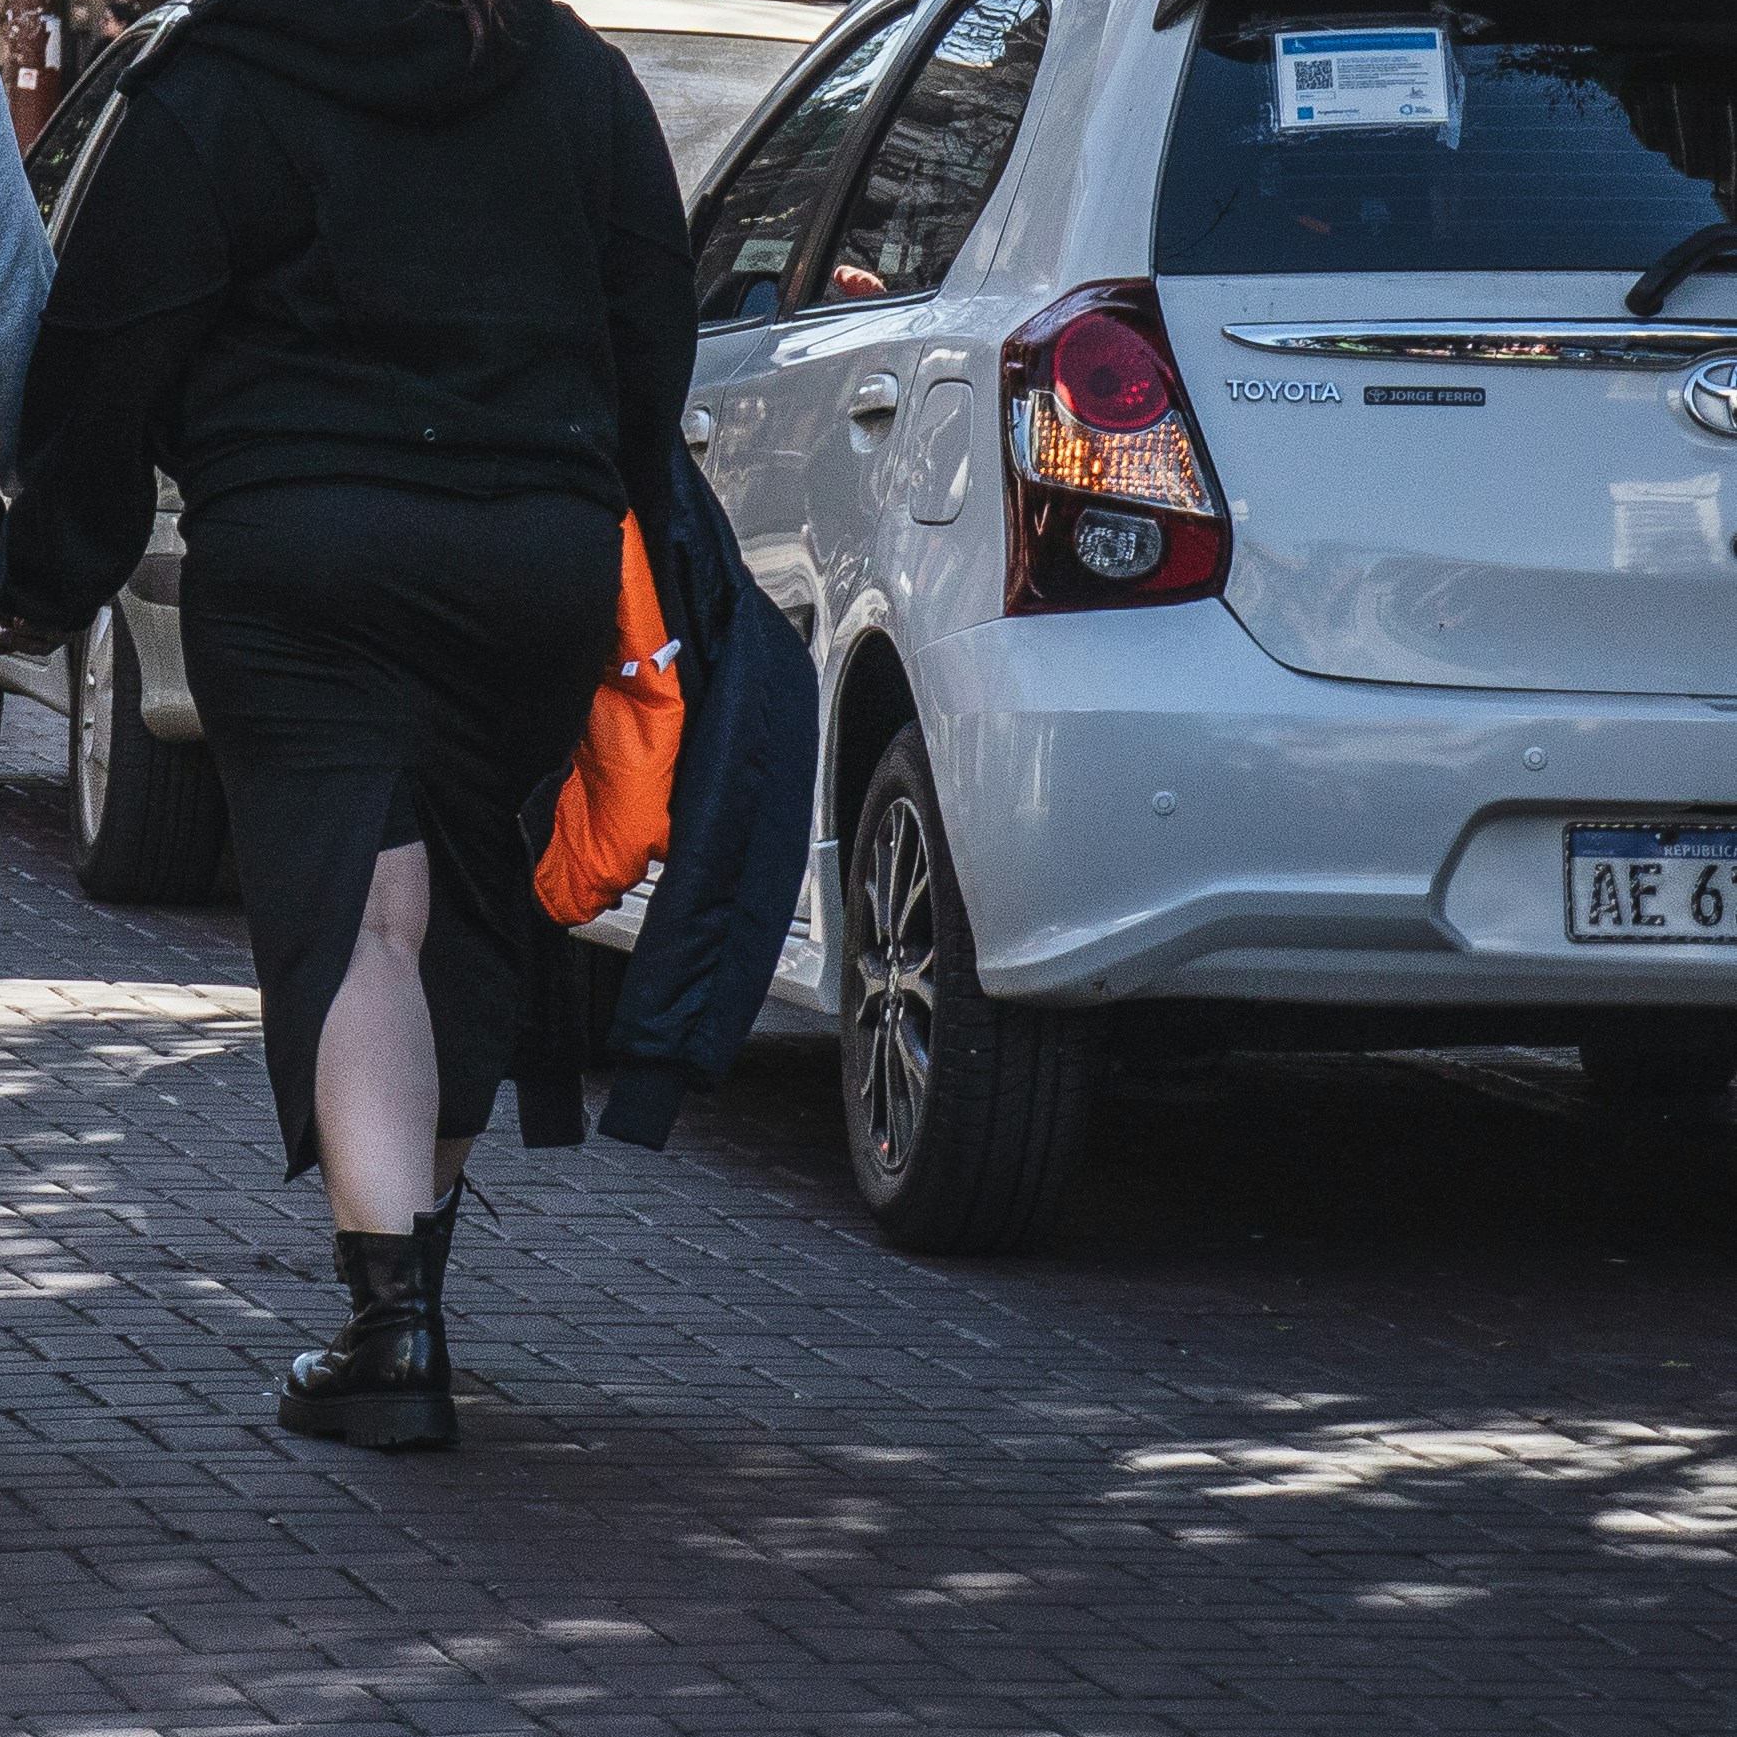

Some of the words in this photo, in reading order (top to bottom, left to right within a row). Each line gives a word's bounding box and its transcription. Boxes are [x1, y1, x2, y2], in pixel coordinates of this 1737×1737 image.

[1227, 379, 1341, 403] TOYOTA
[1389, 390, 1434, 402] JORGE
[1438, 390, 1483, 403] FERRO
[1589, 863, 1665, 926] AE
[1691, 864, 1737, 927] 6
